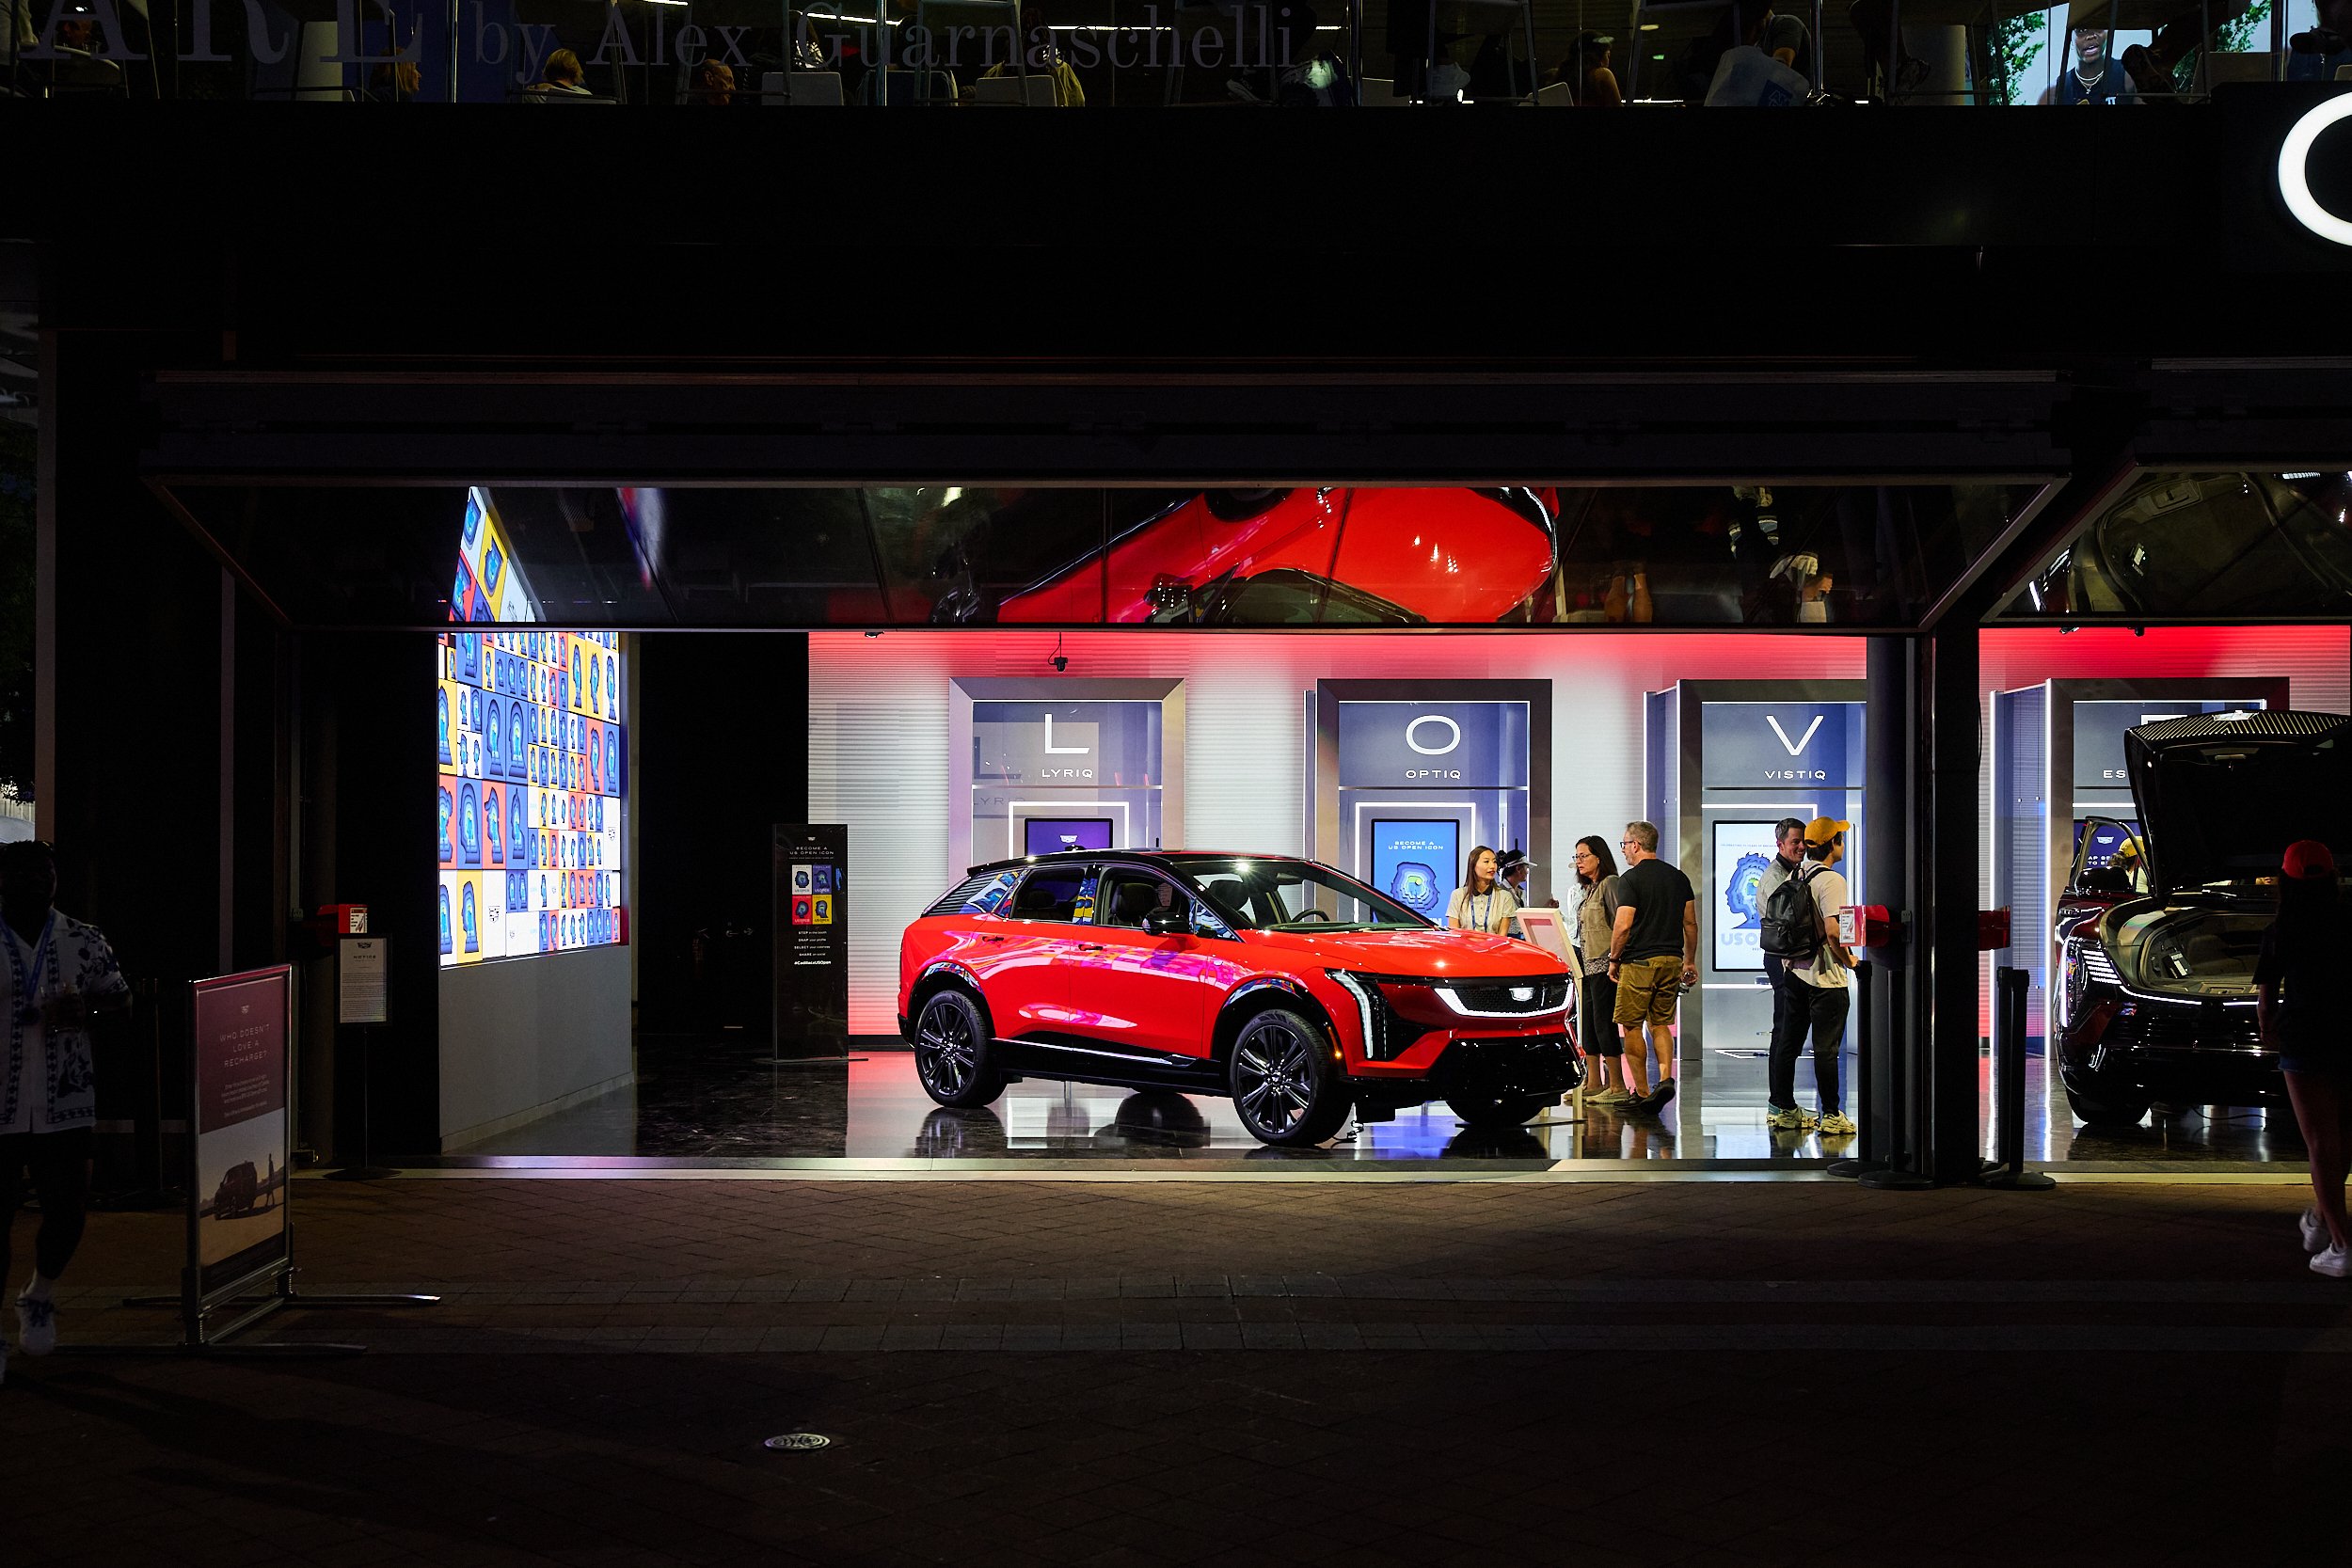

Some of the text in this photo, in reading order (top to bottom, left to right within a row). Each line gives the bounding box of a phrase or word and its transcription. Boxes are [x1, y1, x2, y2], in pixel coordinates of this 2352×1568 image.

[475, 2, 556, 84] by
[586, 0, 753, 67] Alex
[797, 2, 1295, 69] Guarnaschelli
[1045, 714, 1090, 753] L
[1406, 715, 1460, 755] O
[1766, 715, 1824, 756] V
[1041, 768, 1093, 779] LYRIQ
[1405, 769, 1461, 780] OPTIQ
[1764, 769, 1826, 780] VISTIQ
[2103, 769, 2126, 779] ES
[1721, 932, 1761, 946] USO
[232, 1040, 252, 1053] LOVE
